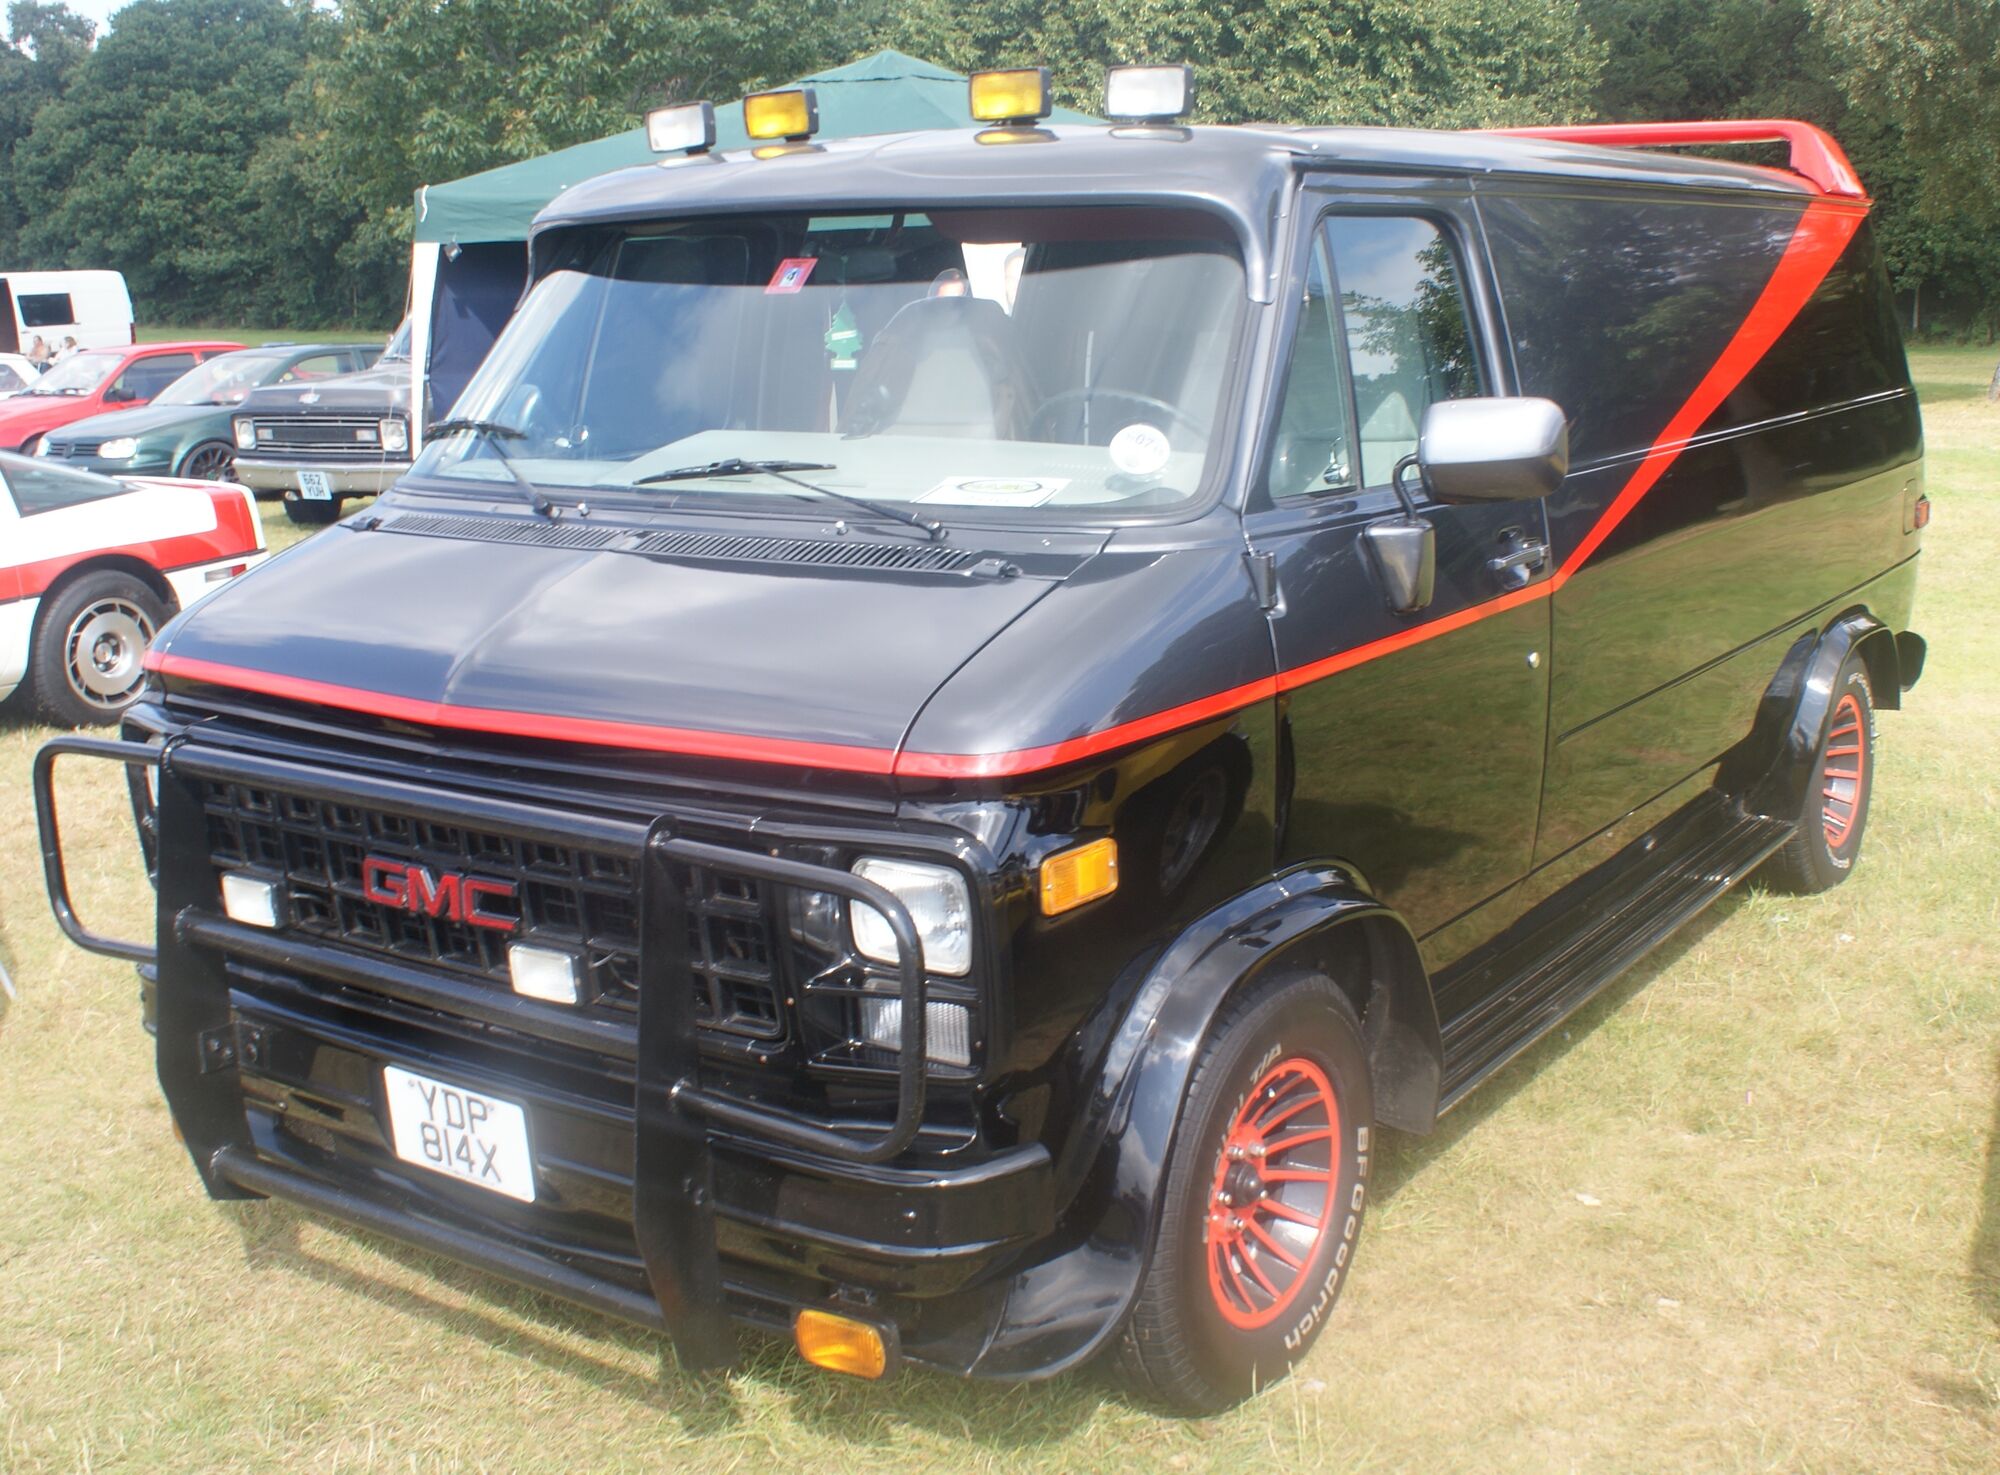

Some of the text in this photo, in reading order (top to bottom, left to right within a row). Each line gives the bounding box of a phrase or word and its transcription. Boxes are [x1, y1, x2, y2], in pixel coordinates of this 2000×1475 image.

[363, 854, 520, 931] GMC
[417, 1081, 488, 1134] YDP
[420, 1121, 502, 1182] 814X
